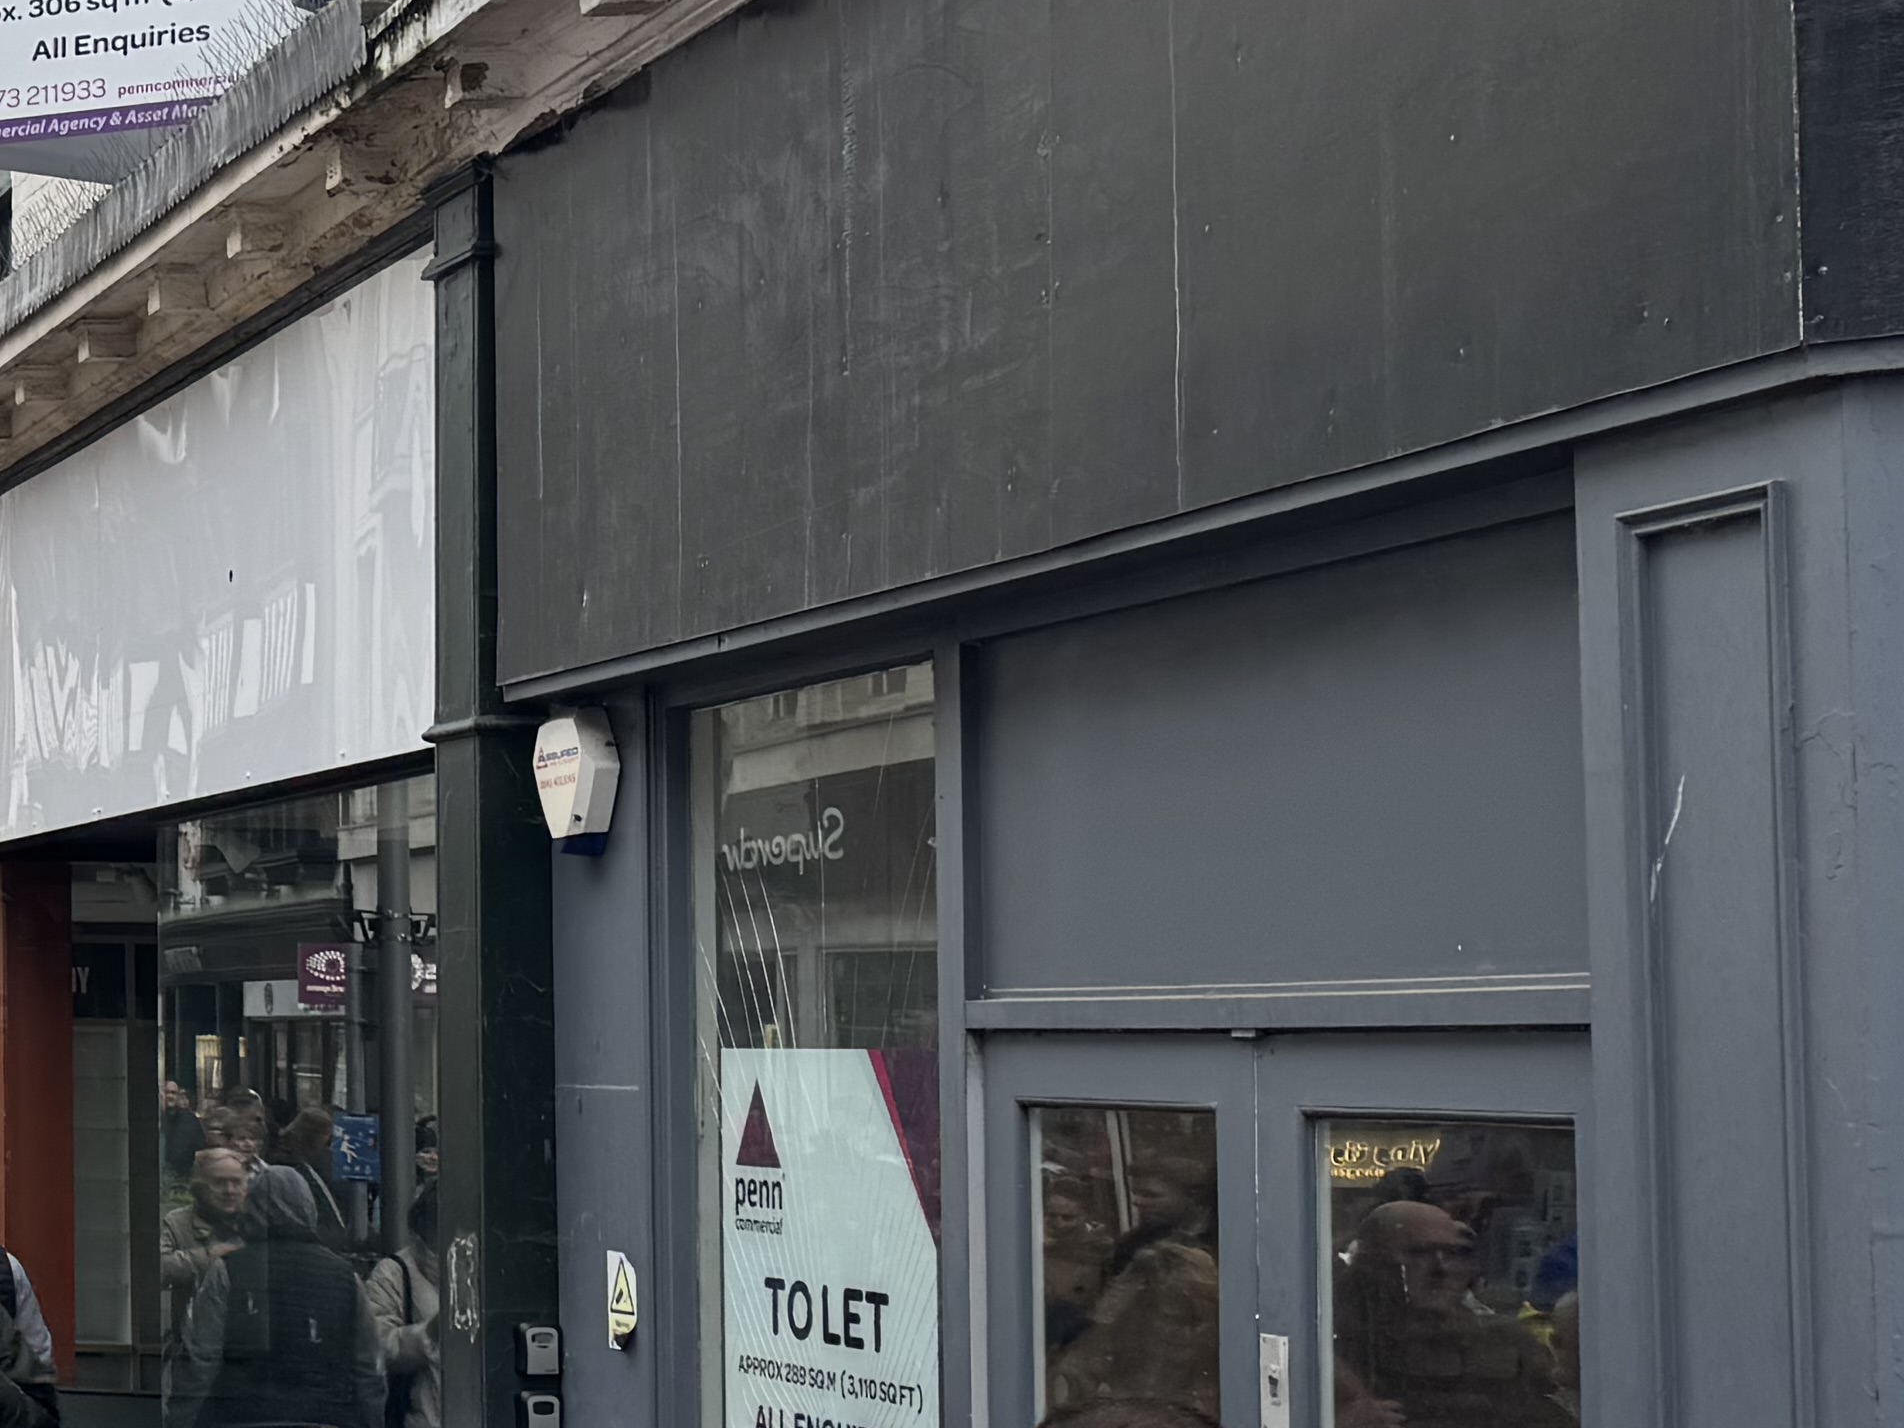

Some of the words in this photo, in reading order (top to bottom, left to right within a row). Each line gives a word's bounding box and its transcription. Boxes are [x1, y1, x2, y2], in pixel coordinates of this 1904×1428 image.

[32, 36, 67, 62] All
[73, 21, 211, 58] Enquiries
[27, 77, 107, 107] 211933
[47, 114, 107, 138] Agency
[109, 110, 123, 126] &
[126, 105, 169, 126] Asset
[735, 1175, 783, 1215] penn
[735, 1216, 784, 1236] commercial
[763, 1276, 813, 1341] TO
[821, 1283, 890, 1354] LET
[738, 1354, 784, 1381] APPROX
[808, 1367, 825, 1390] SQ
[878, 1382, 898, 1405] SQ
[898, 1383, 924, 1415] FT)
